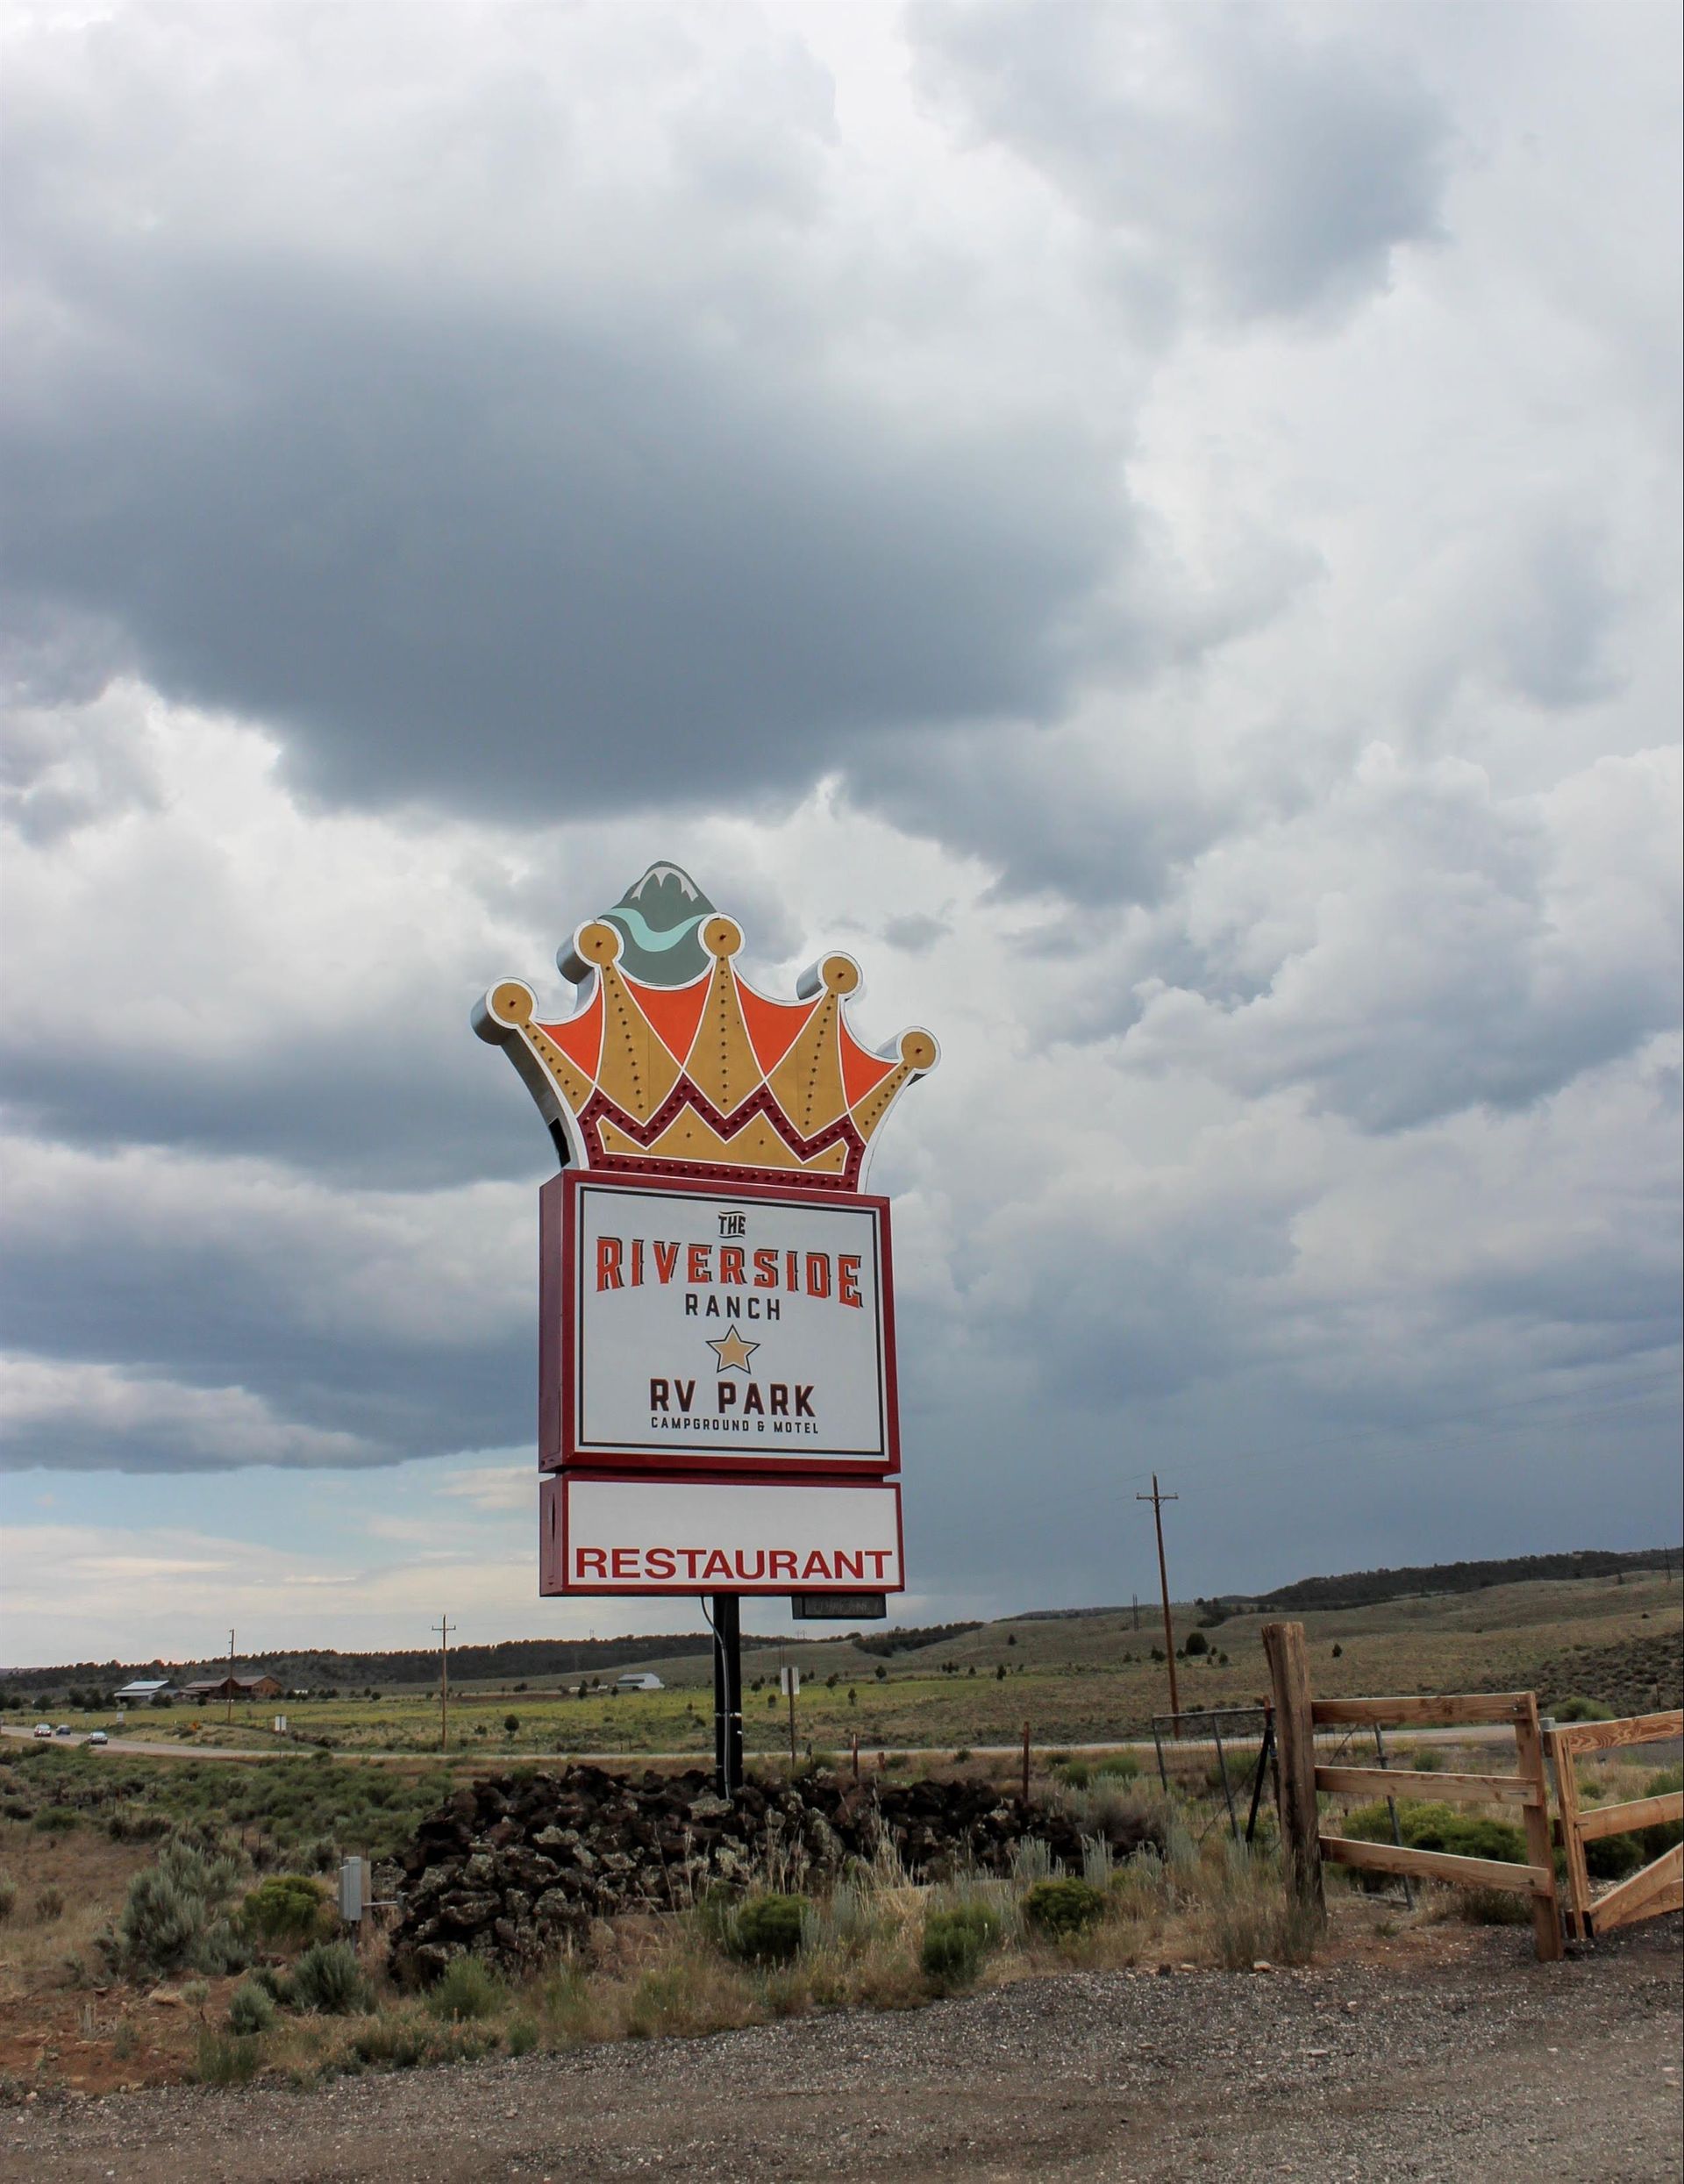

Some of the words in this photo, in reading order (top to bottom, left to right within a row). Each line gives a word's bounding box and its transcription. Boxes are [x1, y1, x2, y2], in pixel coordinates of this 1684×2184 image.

[718, 1214, 746, 1235] THE
[596, 1236, 864, 1309] RIVERSIDE
[685, 1293, 781, 1320] RANCH
[650, 1378, 696, 1412] RV
[717, 1381, 816, 1417] PARK
[651, 1417, 749, 1431] CAMPGROUND
[757, 1420, 765, 1431] &
[774, 1421, 818, 1434] MOTEL
[575, 1548, 893, 1580] RESTAURANT
